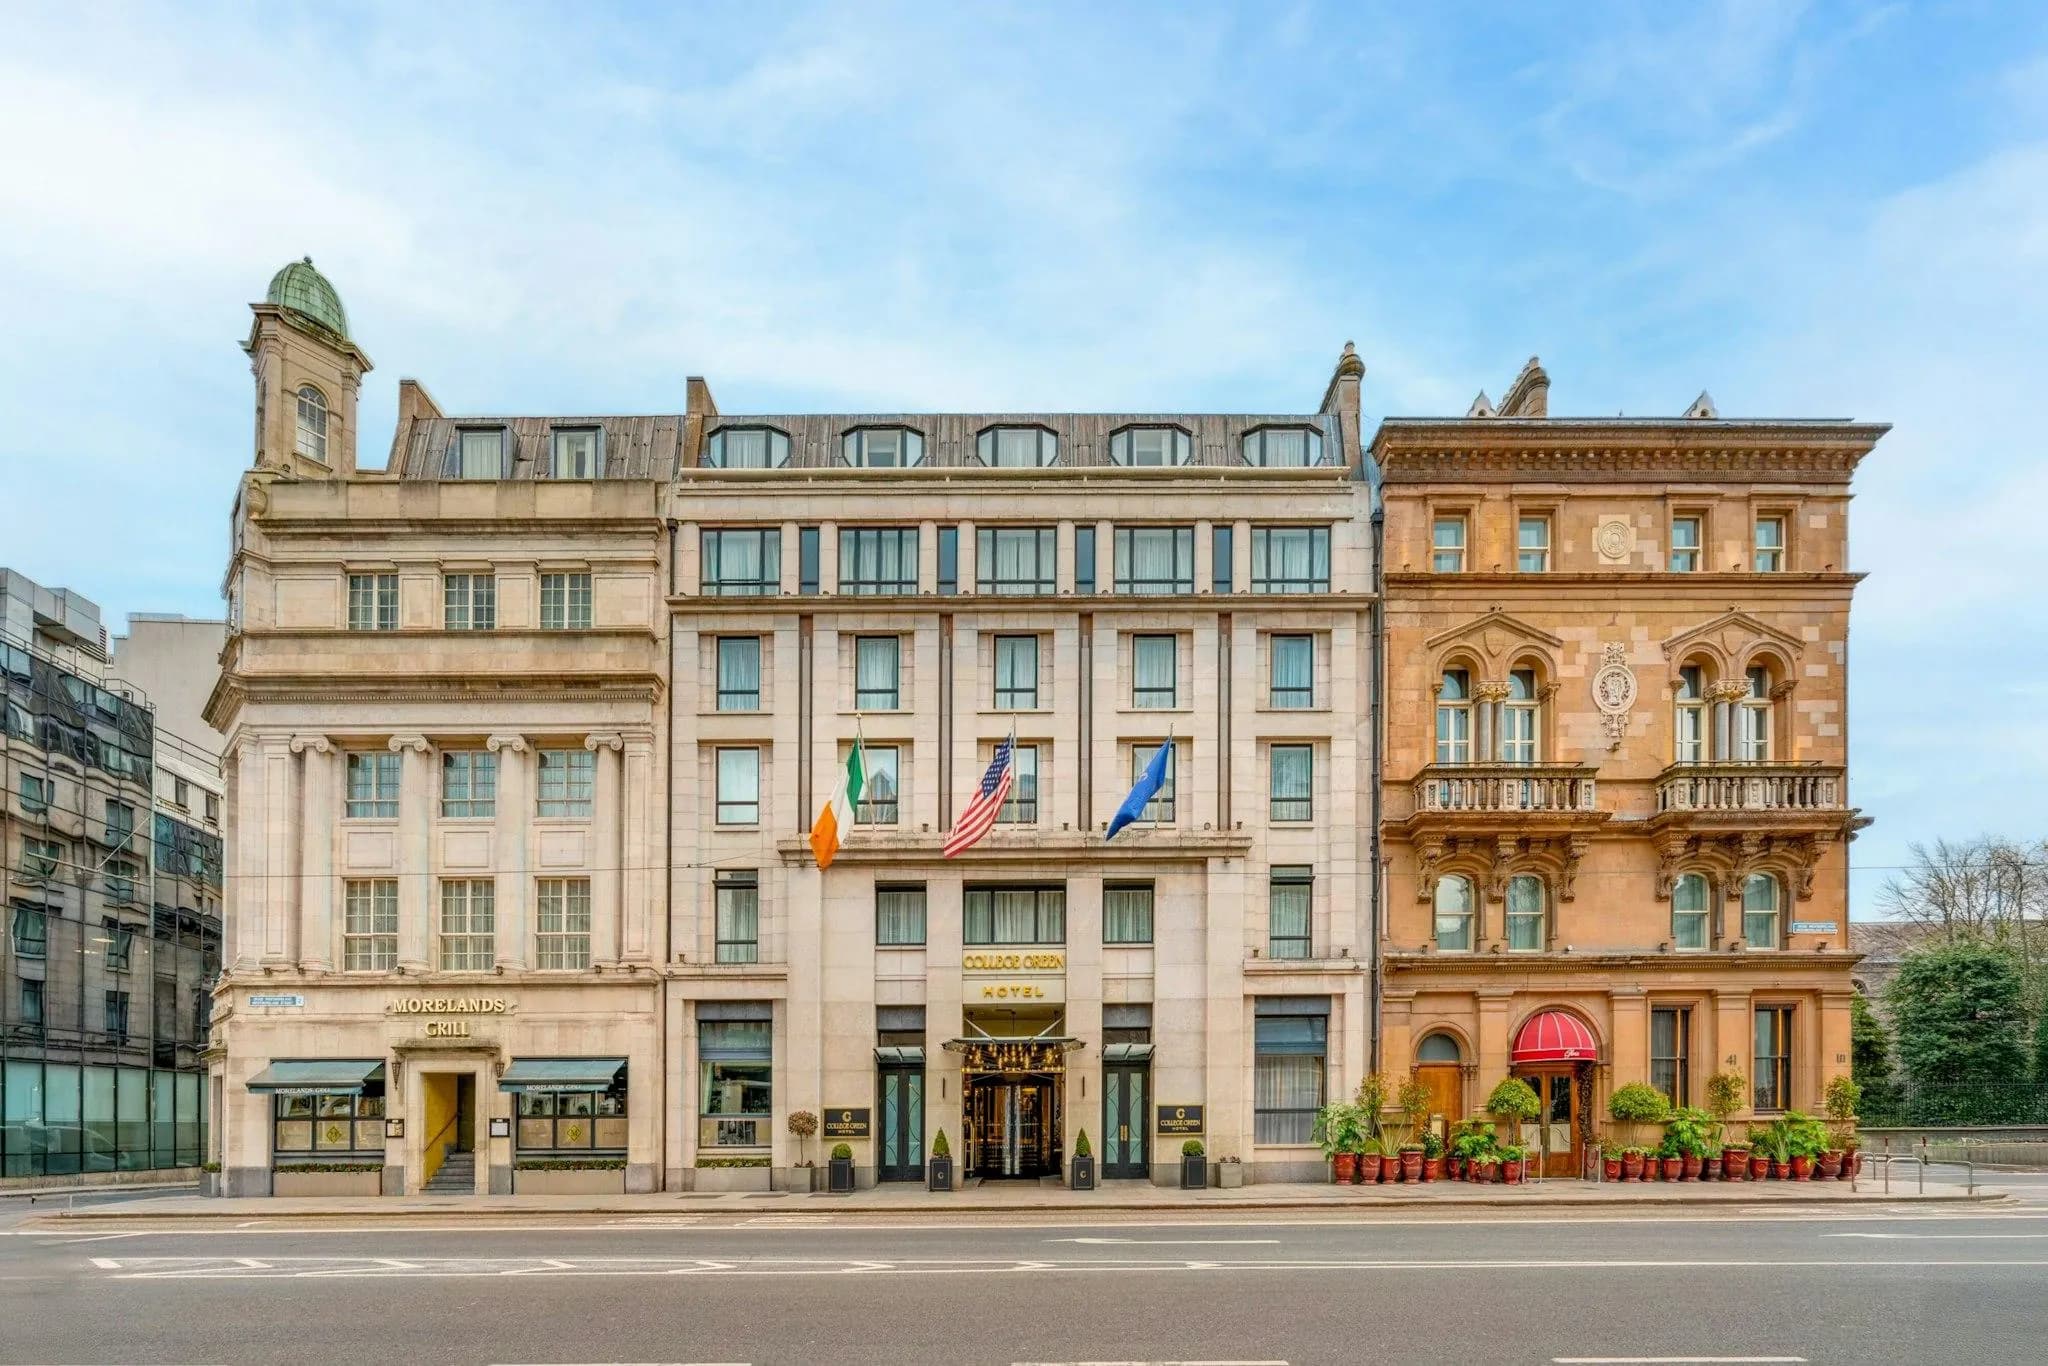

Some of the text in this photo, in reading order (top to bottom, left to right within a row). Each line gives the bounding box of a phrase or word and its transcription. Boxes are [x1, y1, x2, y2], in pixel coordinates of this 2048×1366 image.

[964, 955, 1064, 970] COLLEGE GREEN
[983, 986, 1044, 998] HOTEL
[393, 999, 506, 1013] MORELANDS
[424, 1021, 470, 1037] GRILL
